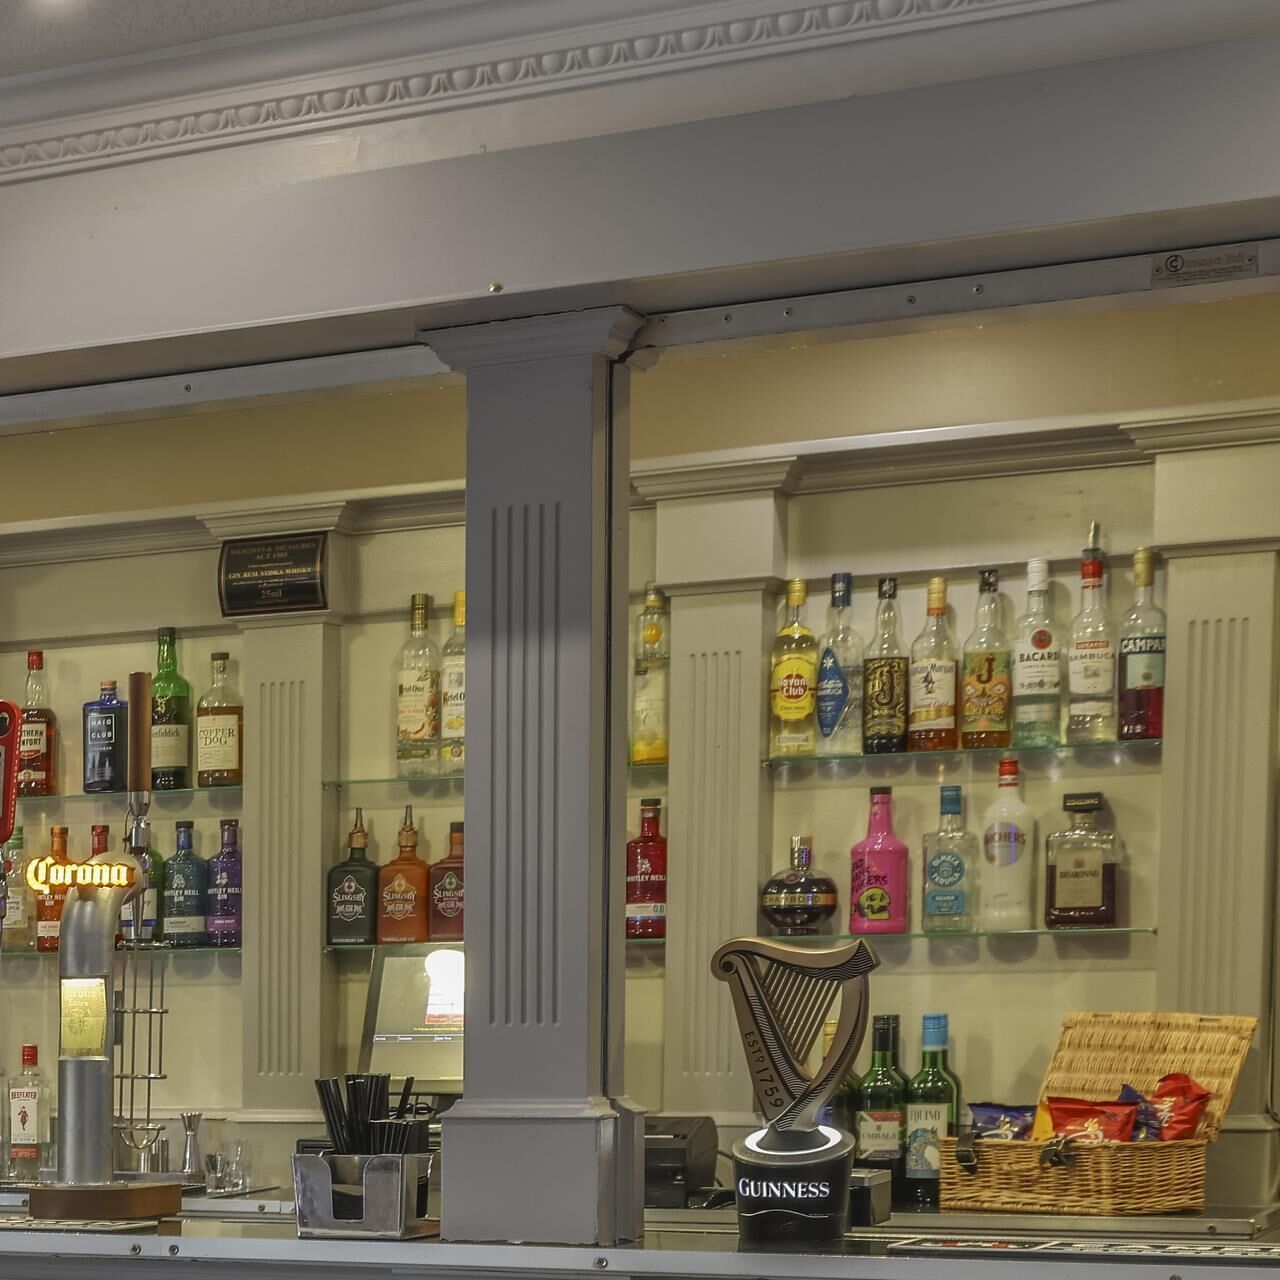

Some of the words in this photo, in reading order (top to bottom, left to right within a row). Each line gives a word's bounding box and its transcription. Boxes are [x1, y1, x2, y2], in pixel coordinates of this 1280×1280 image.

[228, 570, 241, 579] GIN
[243, 569, 258, 577] RUM
[260, 567, 284, 576] VODKA
[286, 566, 312, 575] WHISKY
[1019, 652, 1059, 662] BACARD
[783, 687, 804, 697] Club
[91, 731, 112, 739] CLUB
[199, 728, 235, 739] COPPER
[204, 736, 227, 746] DOG
[932, 854, 960, 867] OLMECA
[26, 856, 128, 894] Corona
[932, 872, 960, 885] TEQUILA
[332, 892, 367, 902] SLINGSBY
[383, 890, 416, 901] SLINGSBY
[433, 889, 464, 899] SLINGSB
[756, 1066, 785, 1108] 1759
[11, 1091, 37, 1100] BEEFEATER
[739, 1178, 830, 1198] GUINNESS
